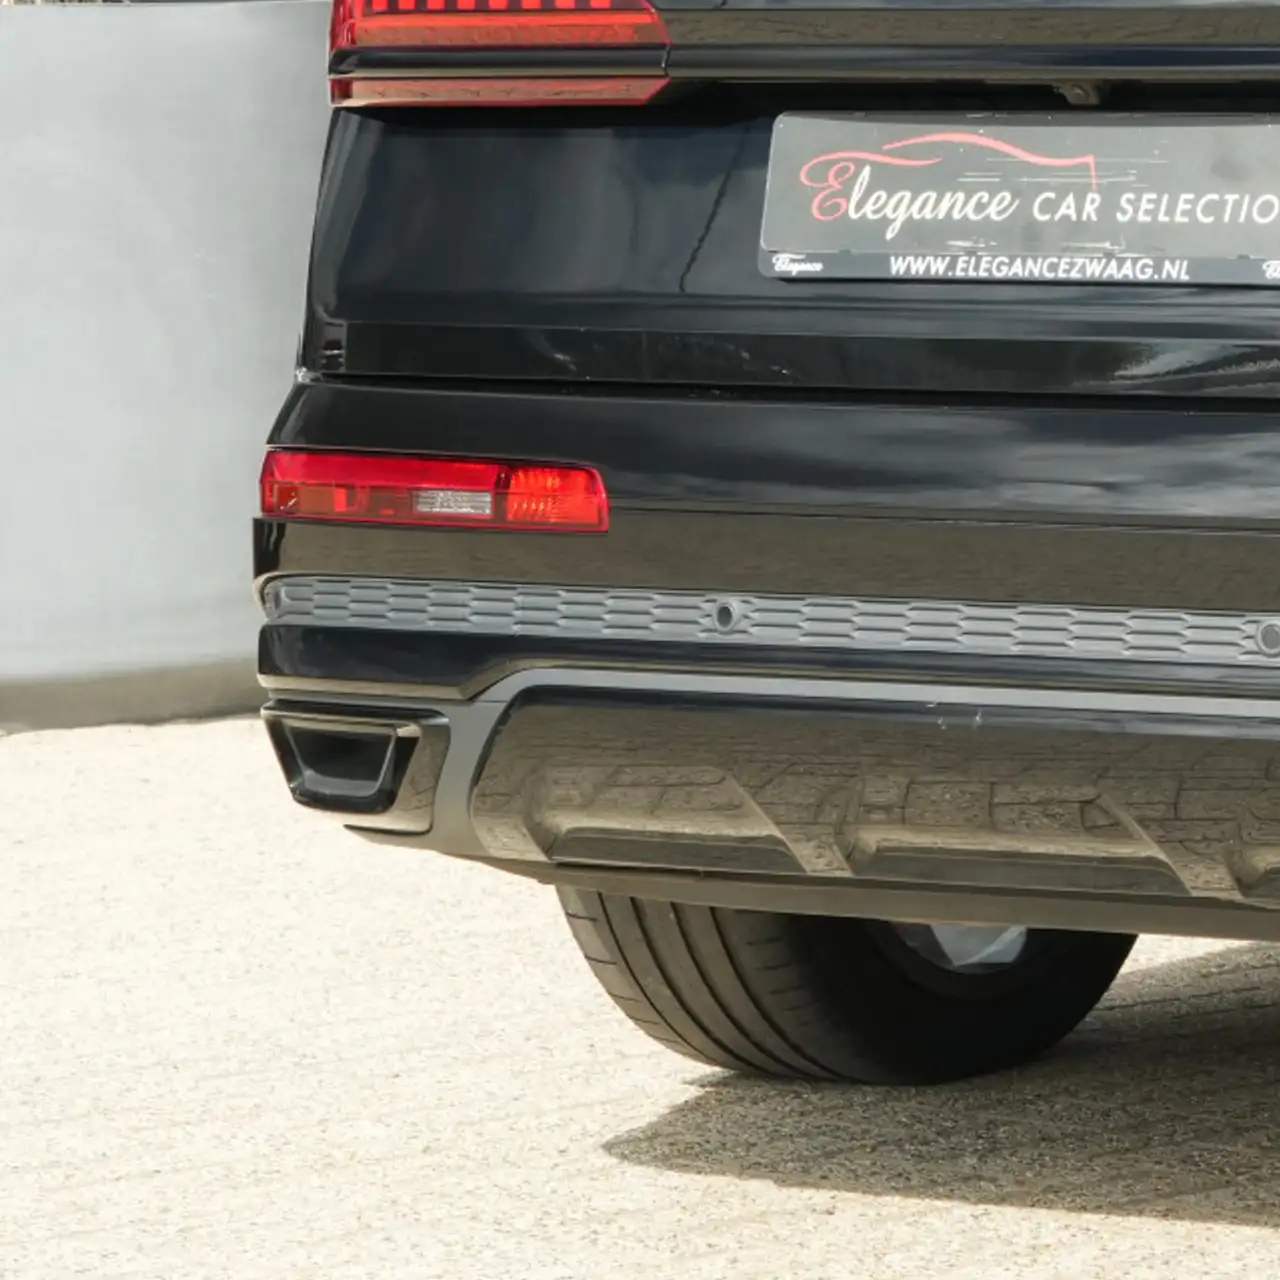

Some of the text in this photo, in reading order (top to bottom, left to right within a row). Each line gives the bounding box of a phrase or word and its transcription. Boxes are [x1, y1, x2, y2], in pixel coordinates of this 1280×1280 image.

[800, 152, 1019, 240] Elegance
[1033, 191, 1101, 223] CAR
[889, 254, 1191, 282] WWW.ELEGANCEZWAAG.NL
